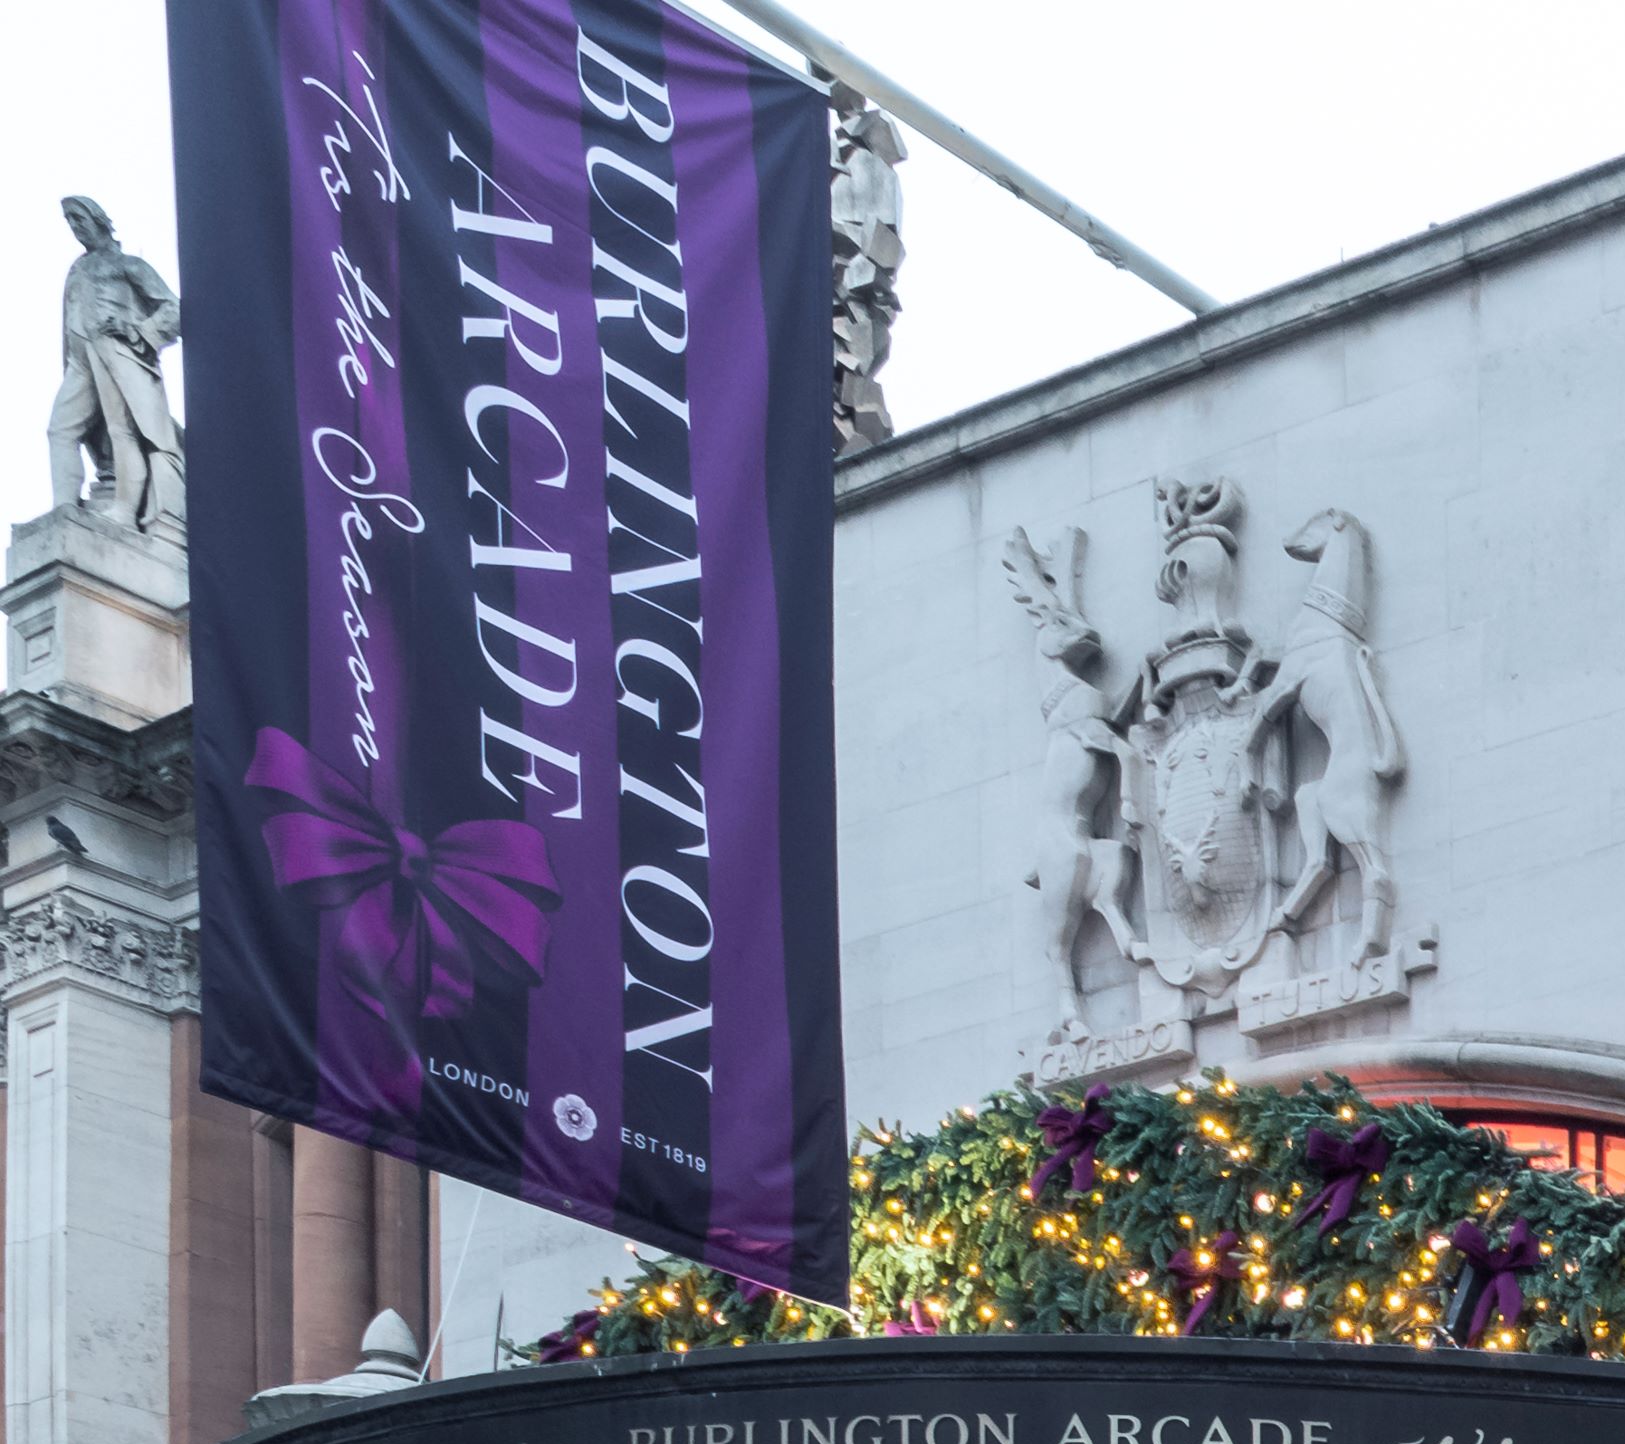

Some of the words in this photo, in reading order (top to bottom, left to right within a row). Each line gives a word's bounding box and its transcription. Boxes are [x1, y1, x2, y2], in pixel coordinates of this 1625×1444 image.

[331, 245, 395, 398] the
[312, 427, 425, 767] Season
[448, 131, 582, 819] ARCADE
[577, 25, 713, 1093] BURLINGTON
[429, 1057, 529, 1107] LONDON
[1039, 1023, 1172, 1082] CAVENDO
[1252, 963, 1384, 1025] TUTUS
